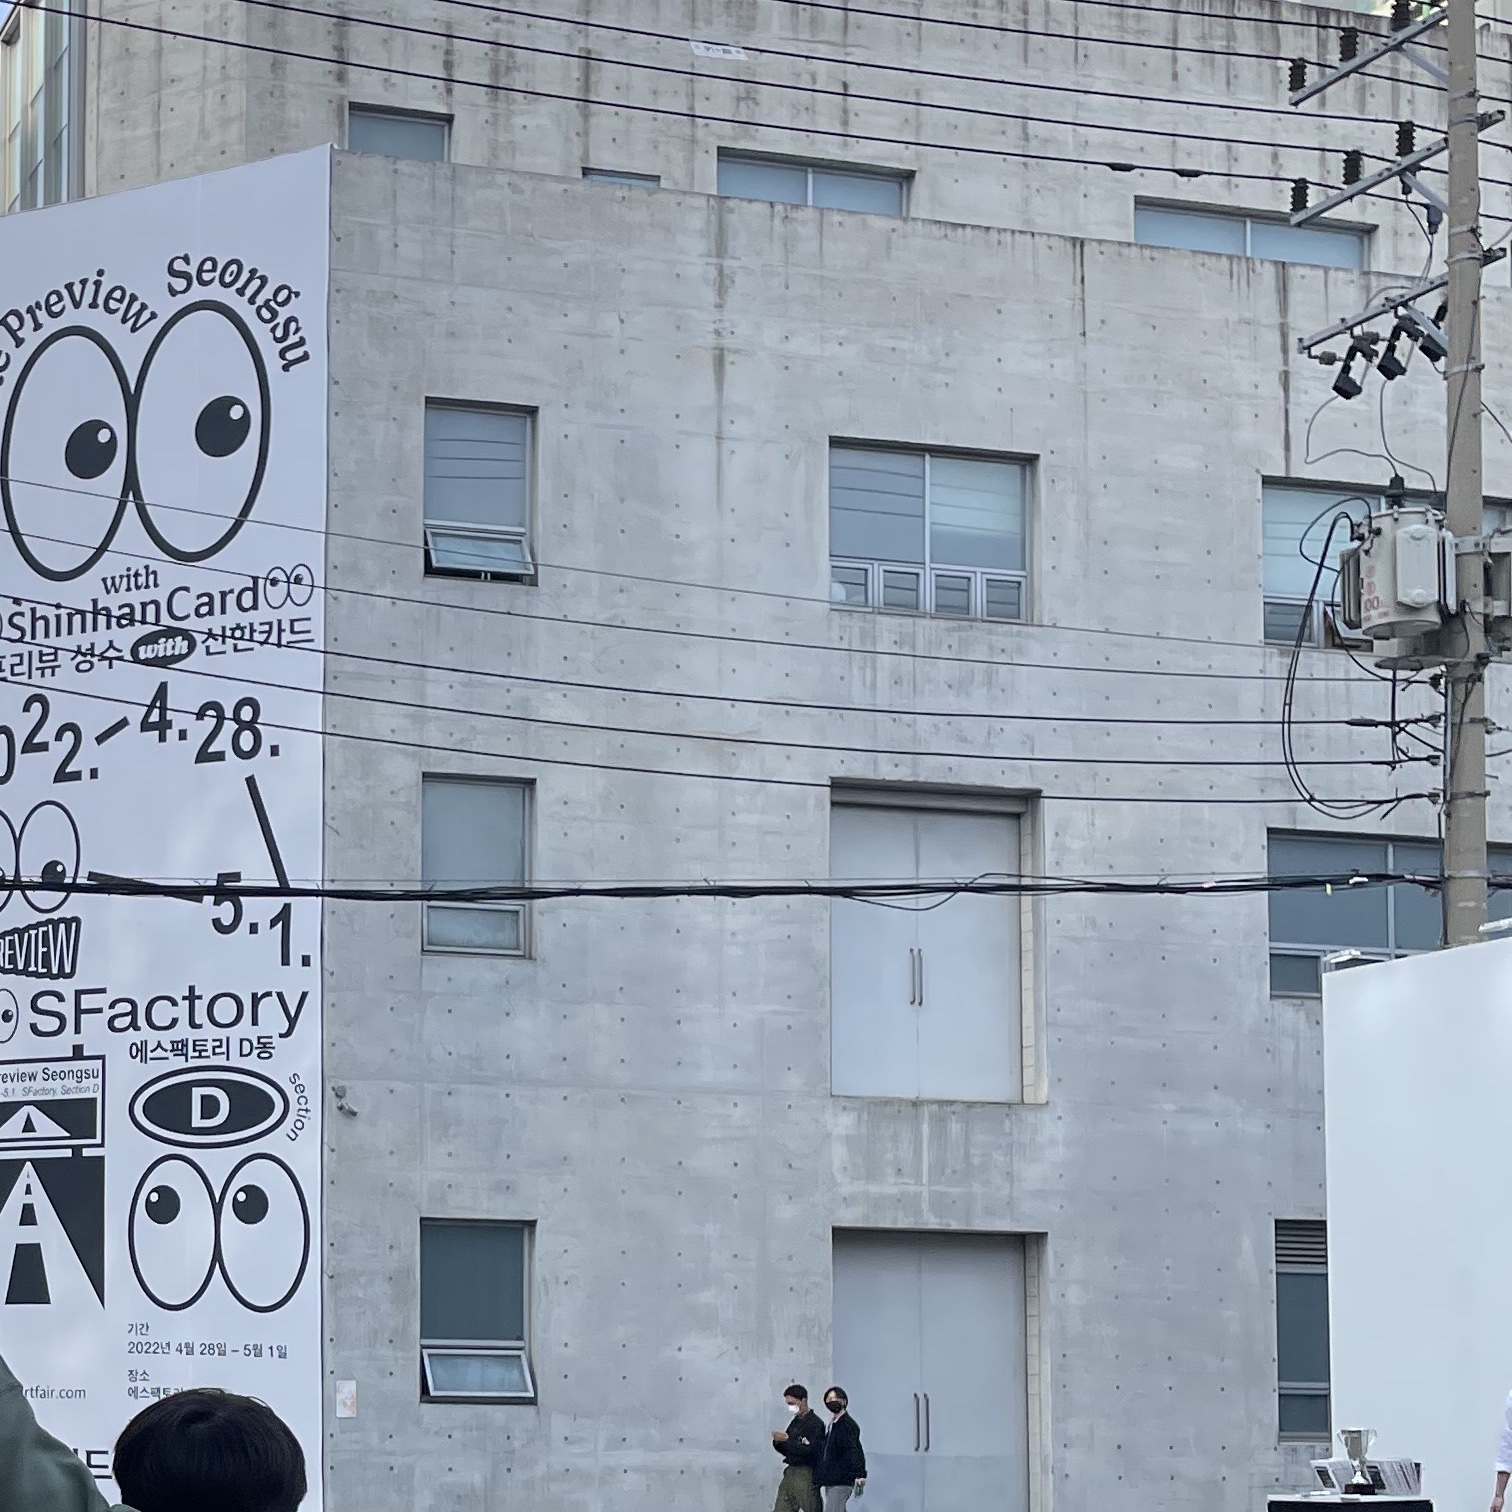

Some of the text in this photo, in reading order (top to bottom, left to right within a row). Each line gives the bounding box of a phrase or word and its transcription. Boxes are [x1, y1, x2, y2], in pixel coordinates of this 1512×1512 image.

[165, 252, 311, 373] Seongsu
[101, 564, 159, 595] with
[70, 639, 125, 673] 성수
[137, 637, 189, 662] with
[201, 615, 316, 657] 신한카드
[139, 681, 280, 765] 4.28.
[210, 871, 312, 967] 5.1.
[28, 984, 310, 1039] SFactory
[128, 1035, 276, 1065] 에스팩토리 D동
[42, 1066, 99, 1084] Seongsu
[92, 1083, 100, 1094] D
[191, 1086, 231, 1128] D
[285, 1072, 312, 1142] section
[127, 1322, 150, 1336] 기간
[127, 1341, 171, 1355] 2022년
[175, 1341, 195, 1356] 4월
[199, 1342, 227, 1357] 28일
[243, 1343, 263, 1358] 5월
[267, 1344, 288, 1360] 1일
[127, 1369, 150, 1382] 장소
